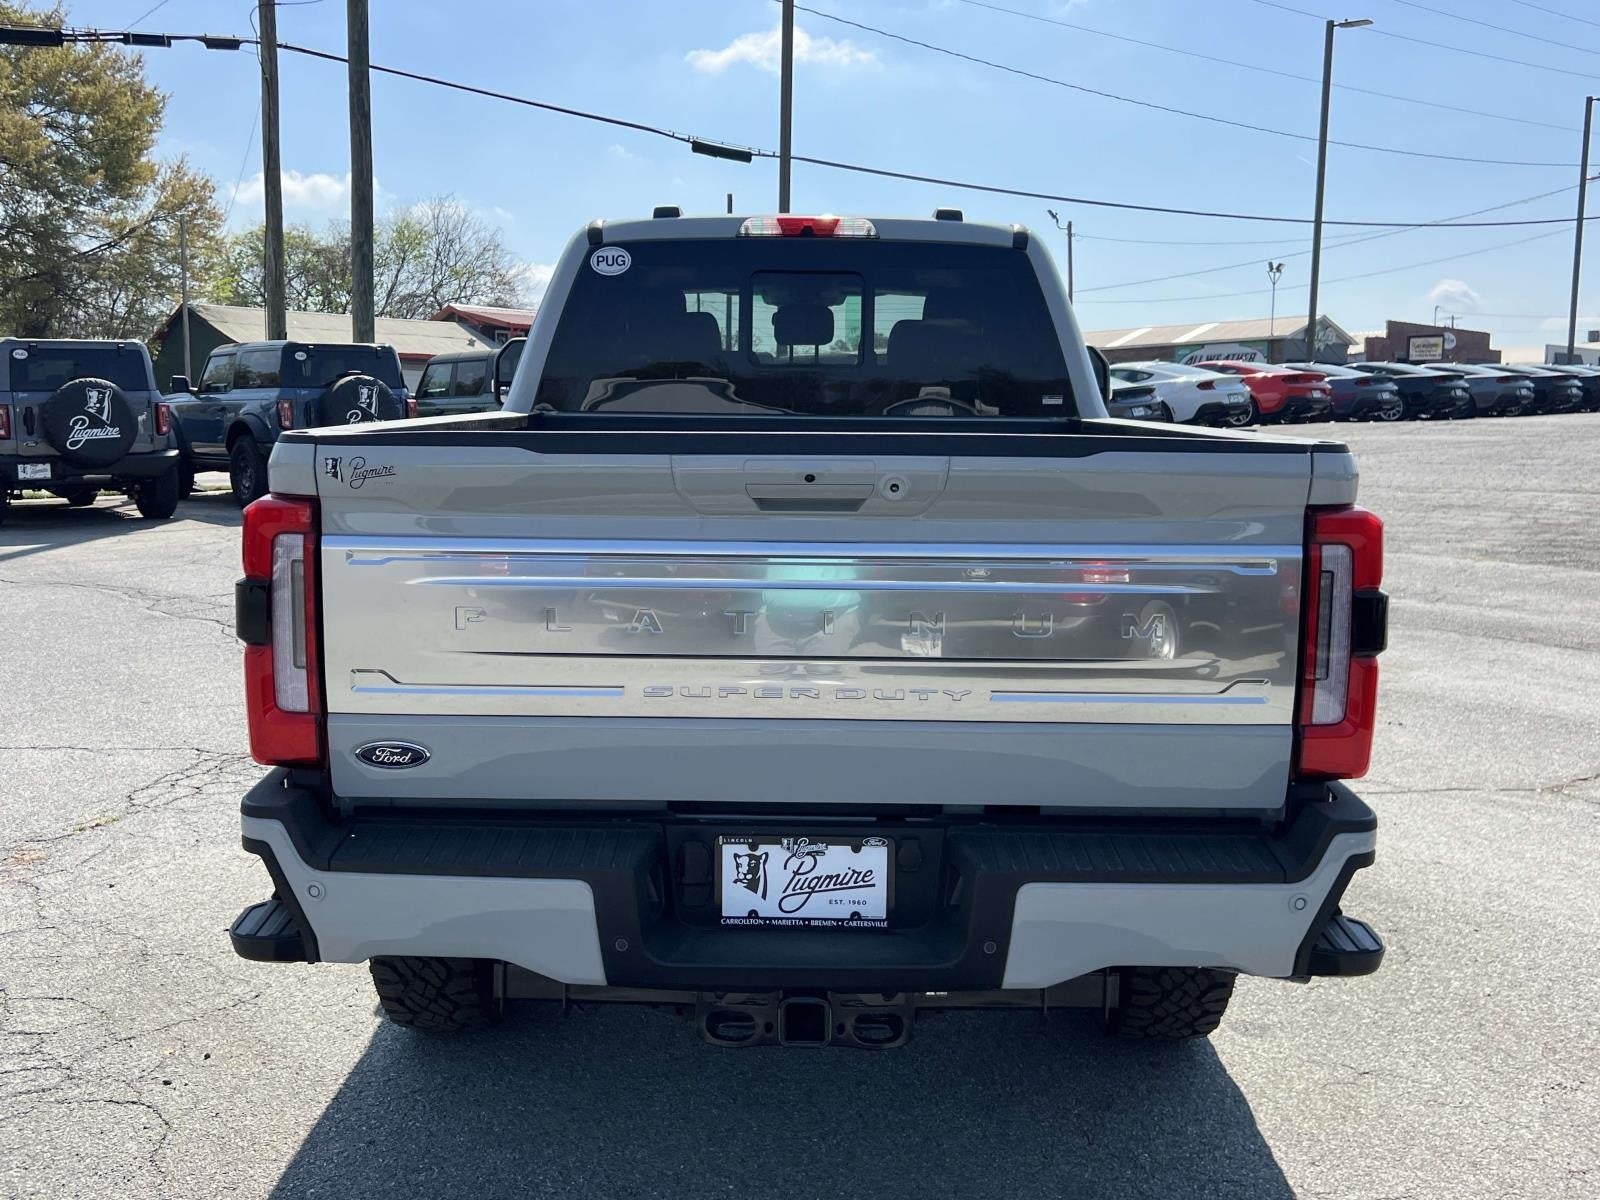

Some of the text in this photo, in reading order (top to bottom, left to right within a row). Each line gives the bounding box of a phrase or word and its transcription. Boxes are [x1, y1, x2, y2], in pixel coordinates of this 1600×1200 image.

[596, 254, 626, 267] PUG
[66, 415, 121, 450] Pugmire
[348, 456, 397, 489] Pugmire
[454, 605, 1166, 640] PLATINUM
[643, 685, 972, 702] SUPER DUTY
[372, 747, 412, 763] Ford
[778, 852, 876, 914] Pugmire
[843, 920, 888, 928] CARTERSVILLE
